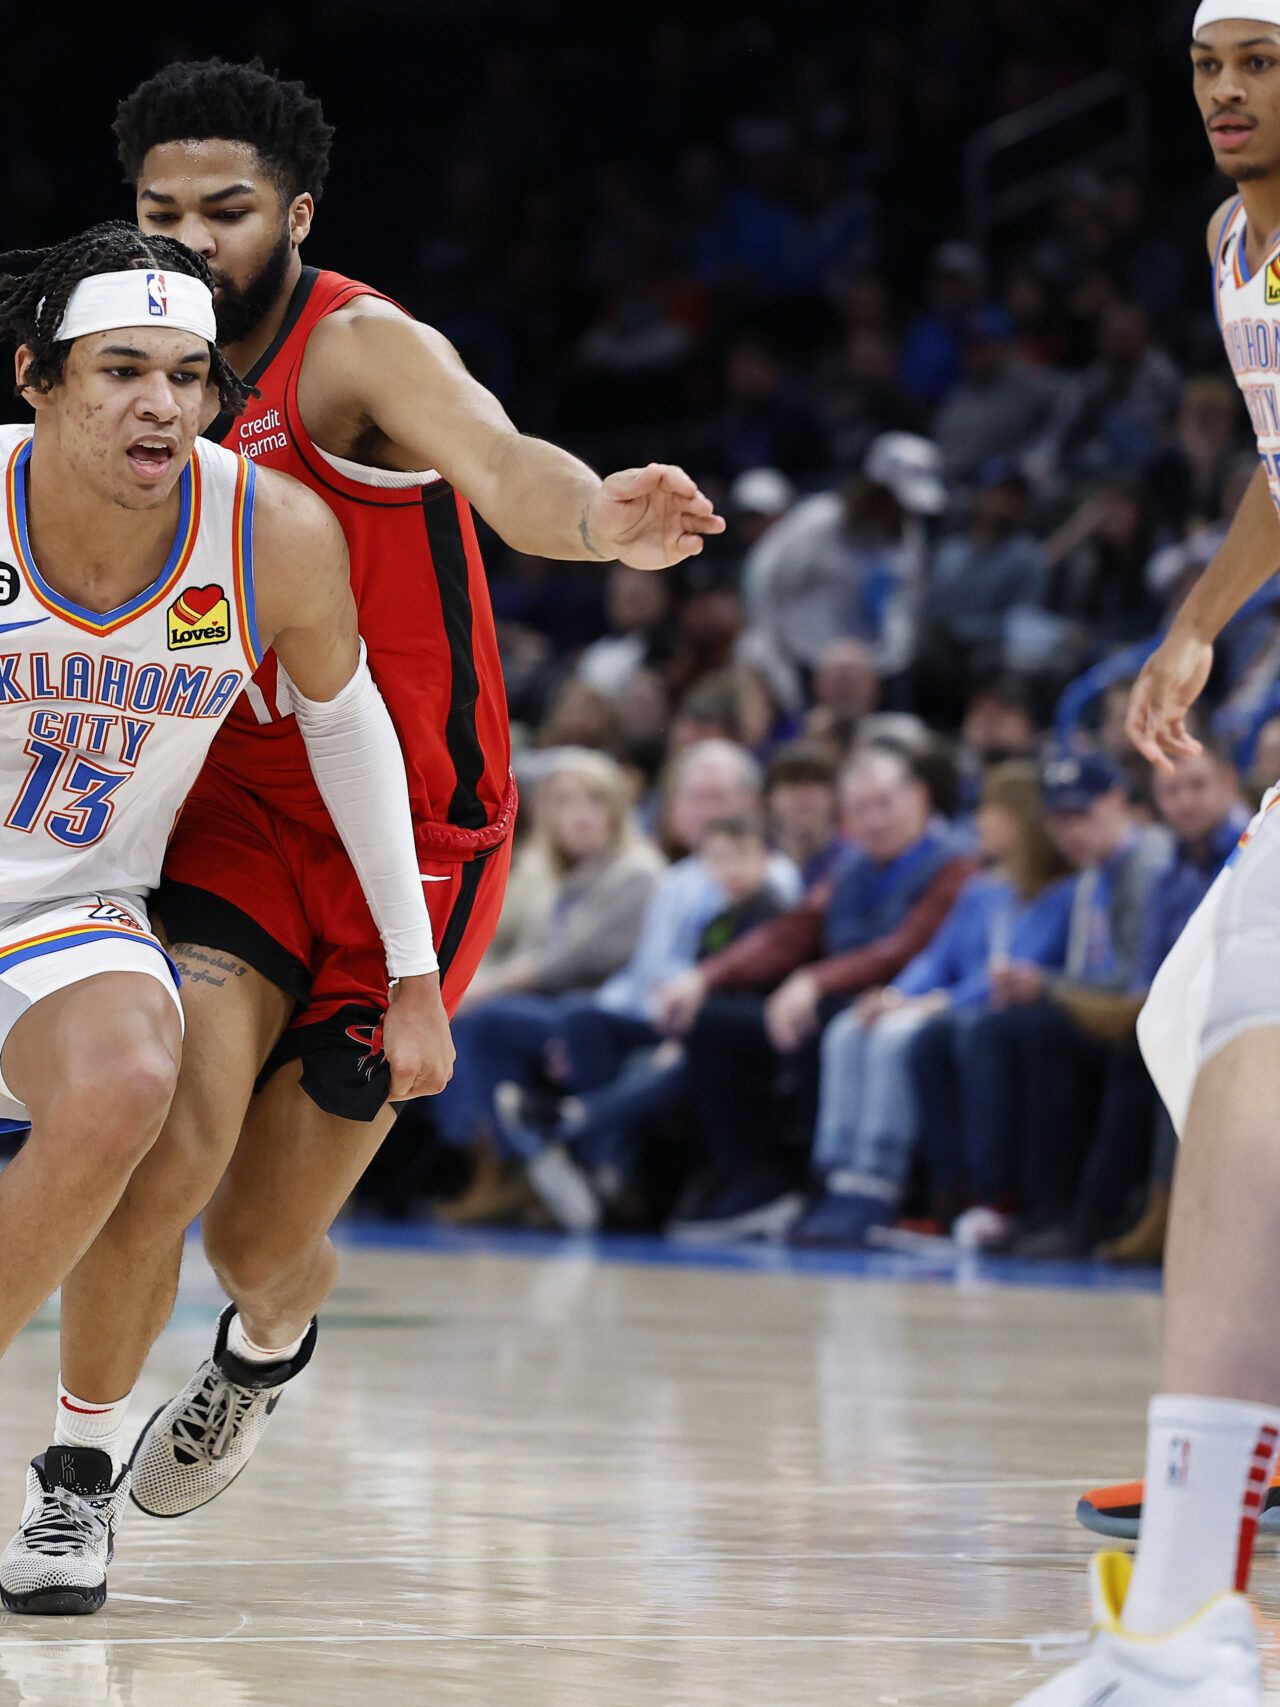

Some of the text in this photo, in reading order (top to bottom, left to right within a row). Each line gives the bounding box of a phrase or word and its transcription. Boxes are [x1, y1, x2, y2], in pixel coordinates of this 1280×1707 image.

[238, 431, 288, 459] karma
[240, 408, 281, 439] credit
[28, 709, 155, 768] CITY
[3, 738, 135, 849] 13
